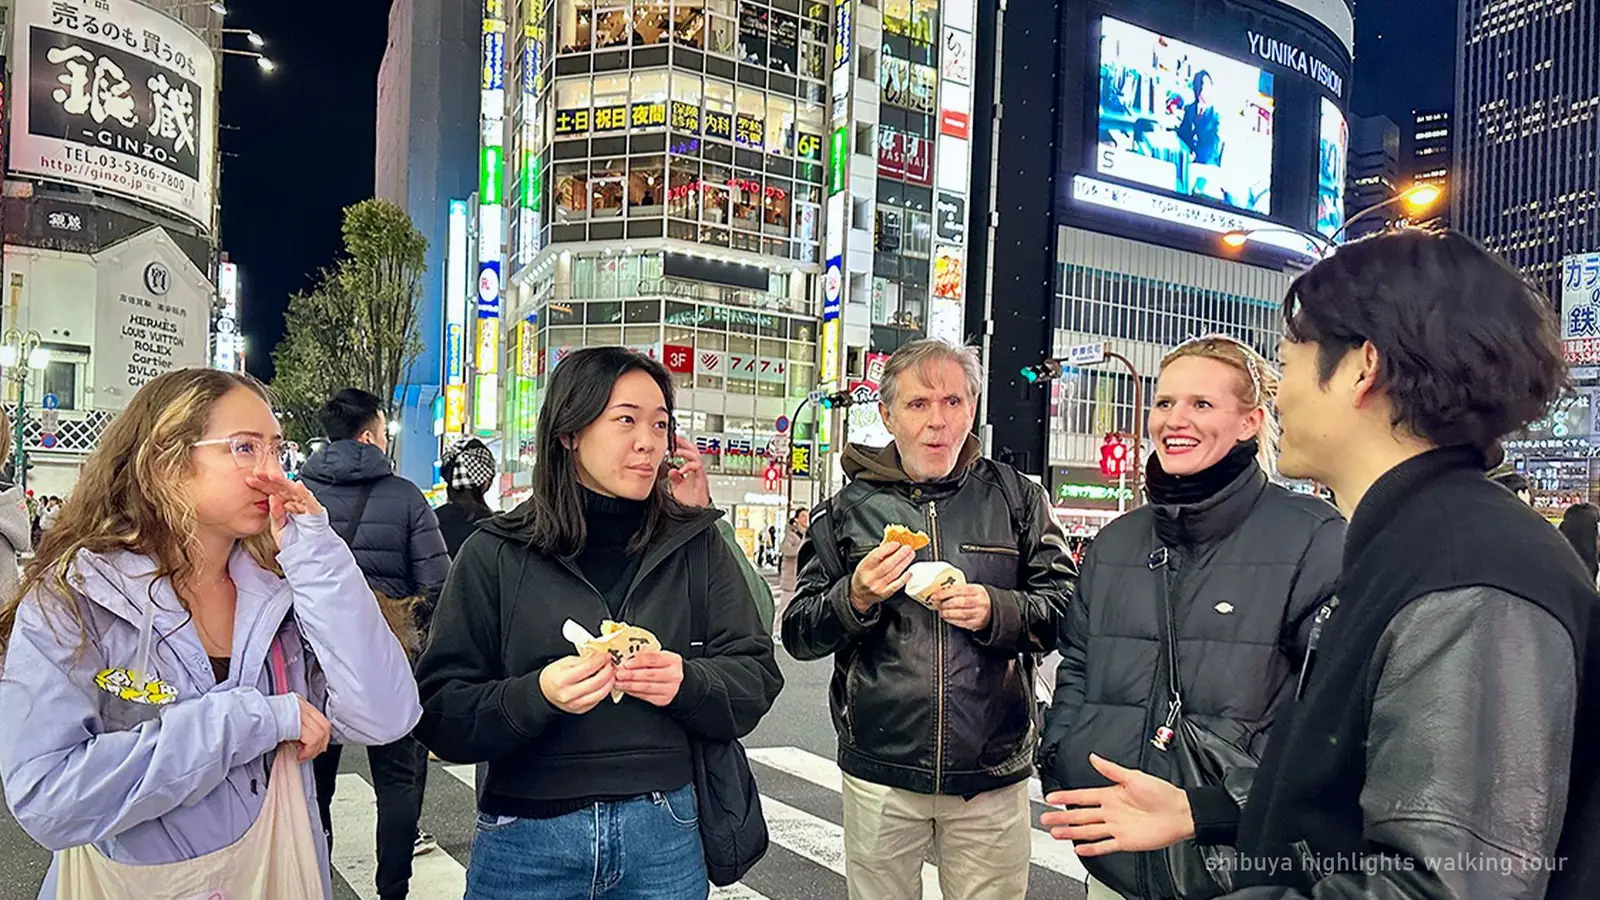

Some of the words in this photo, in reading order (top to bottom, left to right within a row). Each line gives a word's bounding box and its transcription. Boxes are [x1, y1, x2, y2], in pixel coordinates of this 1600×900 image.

[1248, 30, 1308, 75] YUNIKA
[1308, 55, 1343, 98] VISION
[595, 107, 626, 127] 祝日
[632, 103, 666, 125] 夜間
[705, 113, 730, 135] 内科
[799, 134, 821, 156] 6F
[40, 155, 143, 190] http://ginzo.jp
[1570, 306, 1600, 334] 鉄
[122, 325, 146, 339] LOUIS
[149, 330, 184, 347] VUITTON
[134, 340, 172, 356] ROLEX
[128, 364, 164, 377] BVLG
[132, 353, 172, 368] Cartier
[670, 353, 687, 367] 3F
[128, 376, 149, 387] CH
